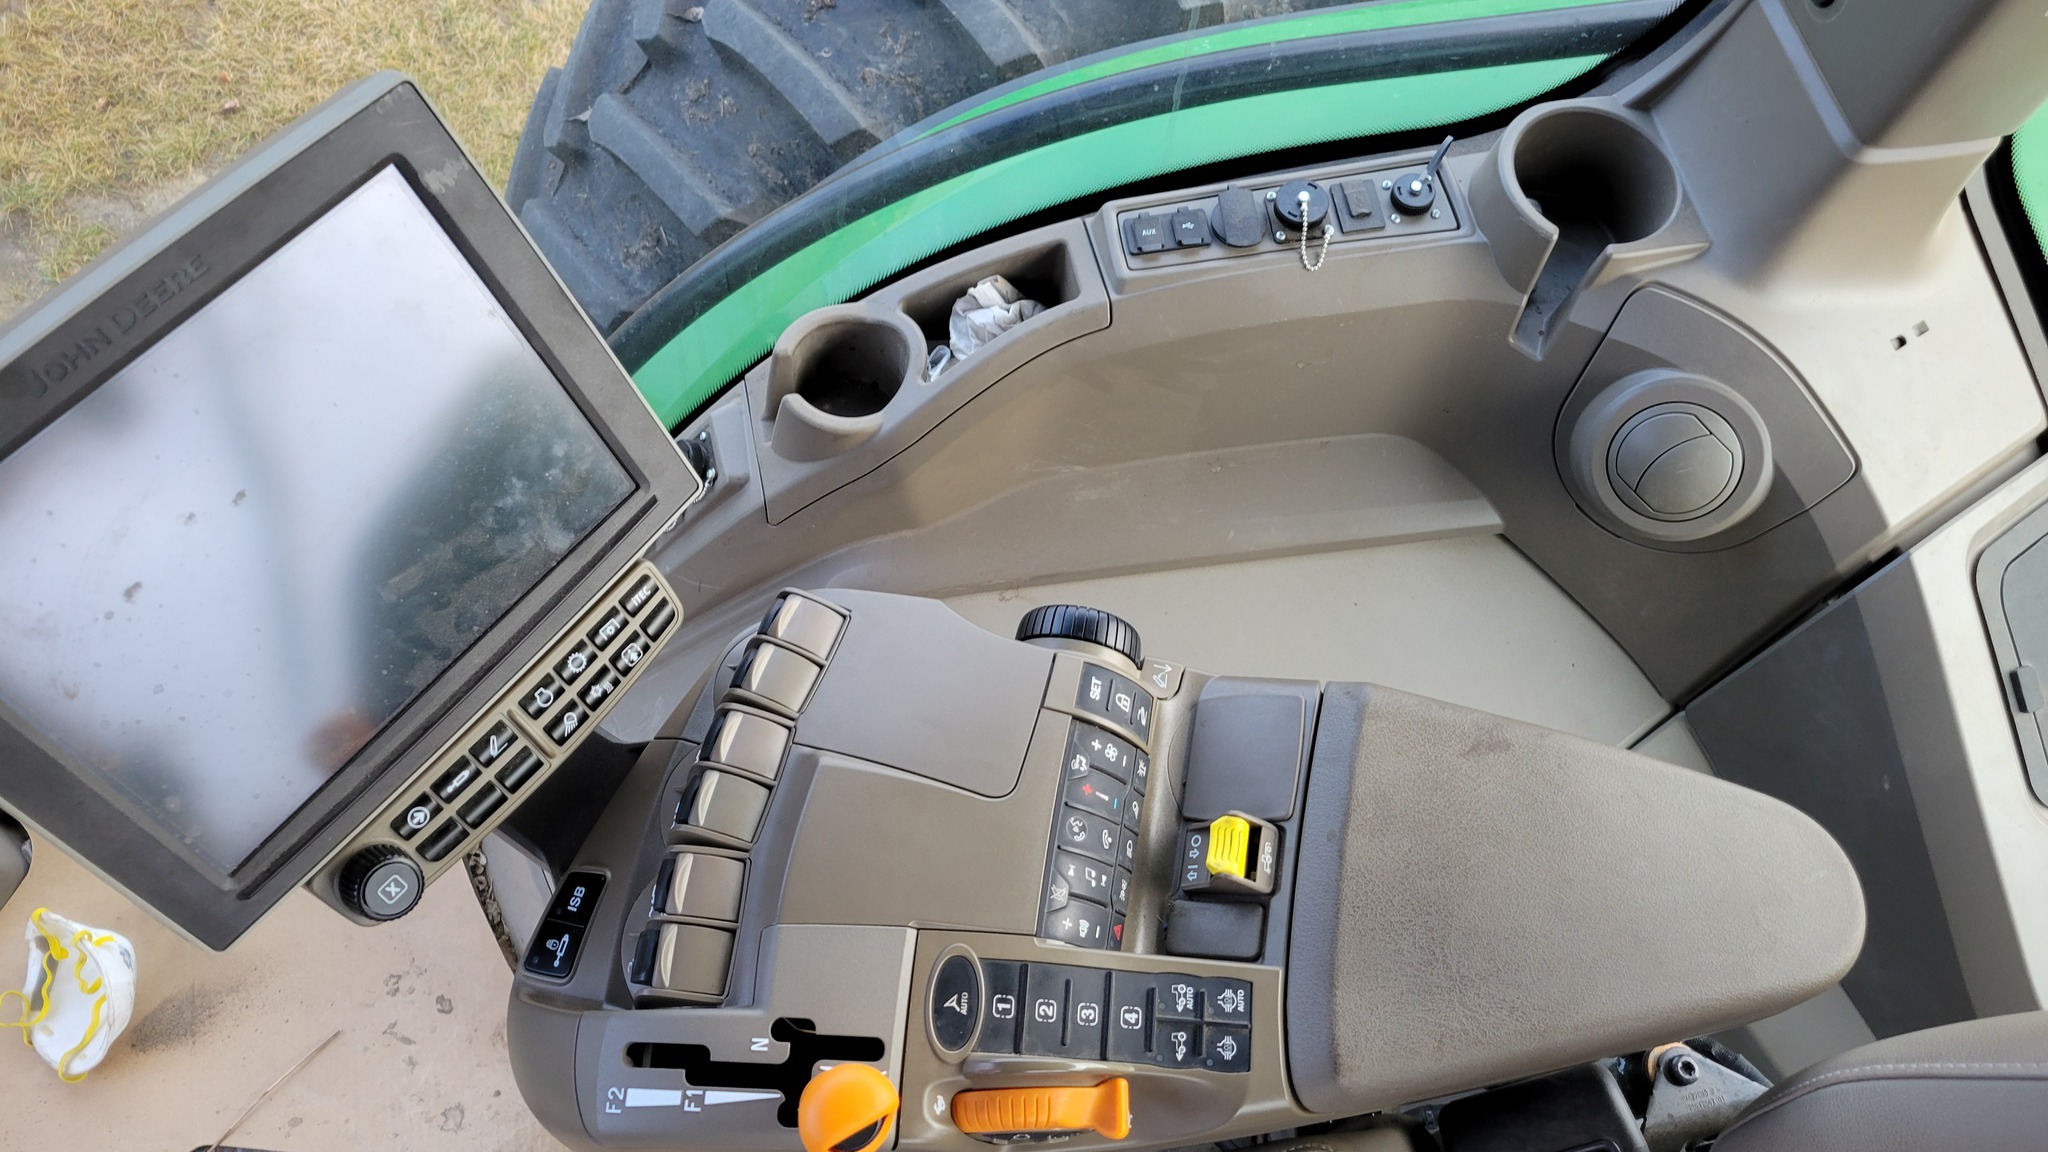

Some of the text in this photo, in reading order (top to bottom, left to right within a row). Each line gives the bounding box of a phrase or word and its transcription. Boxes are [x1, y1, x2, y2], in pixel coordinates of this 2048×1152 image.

[1142, 227, 1157, 237] AUX
[31, 254, 210, 398] JOHN DEERE
[1089, 675, 1102, 701] SET
[567, 886, 586, 912] ISB
[959, 991, 969, 1016] AUTO
[996, 1002, 1011, 1011] 1
[1186, 986, 1194, 1010] AUTO
[1237, 989, 1245, 1013] AUTO
[1039, 1004, 1054, 1017] 2
[1081, 1008, 1095, 1021] 3
[1124, 1011, 1139, 1024] 4
[750, 1037, 770, 1052] N
[605, 1086, 625, 1114] F2
[683, 1089, 703, 1112] F1
